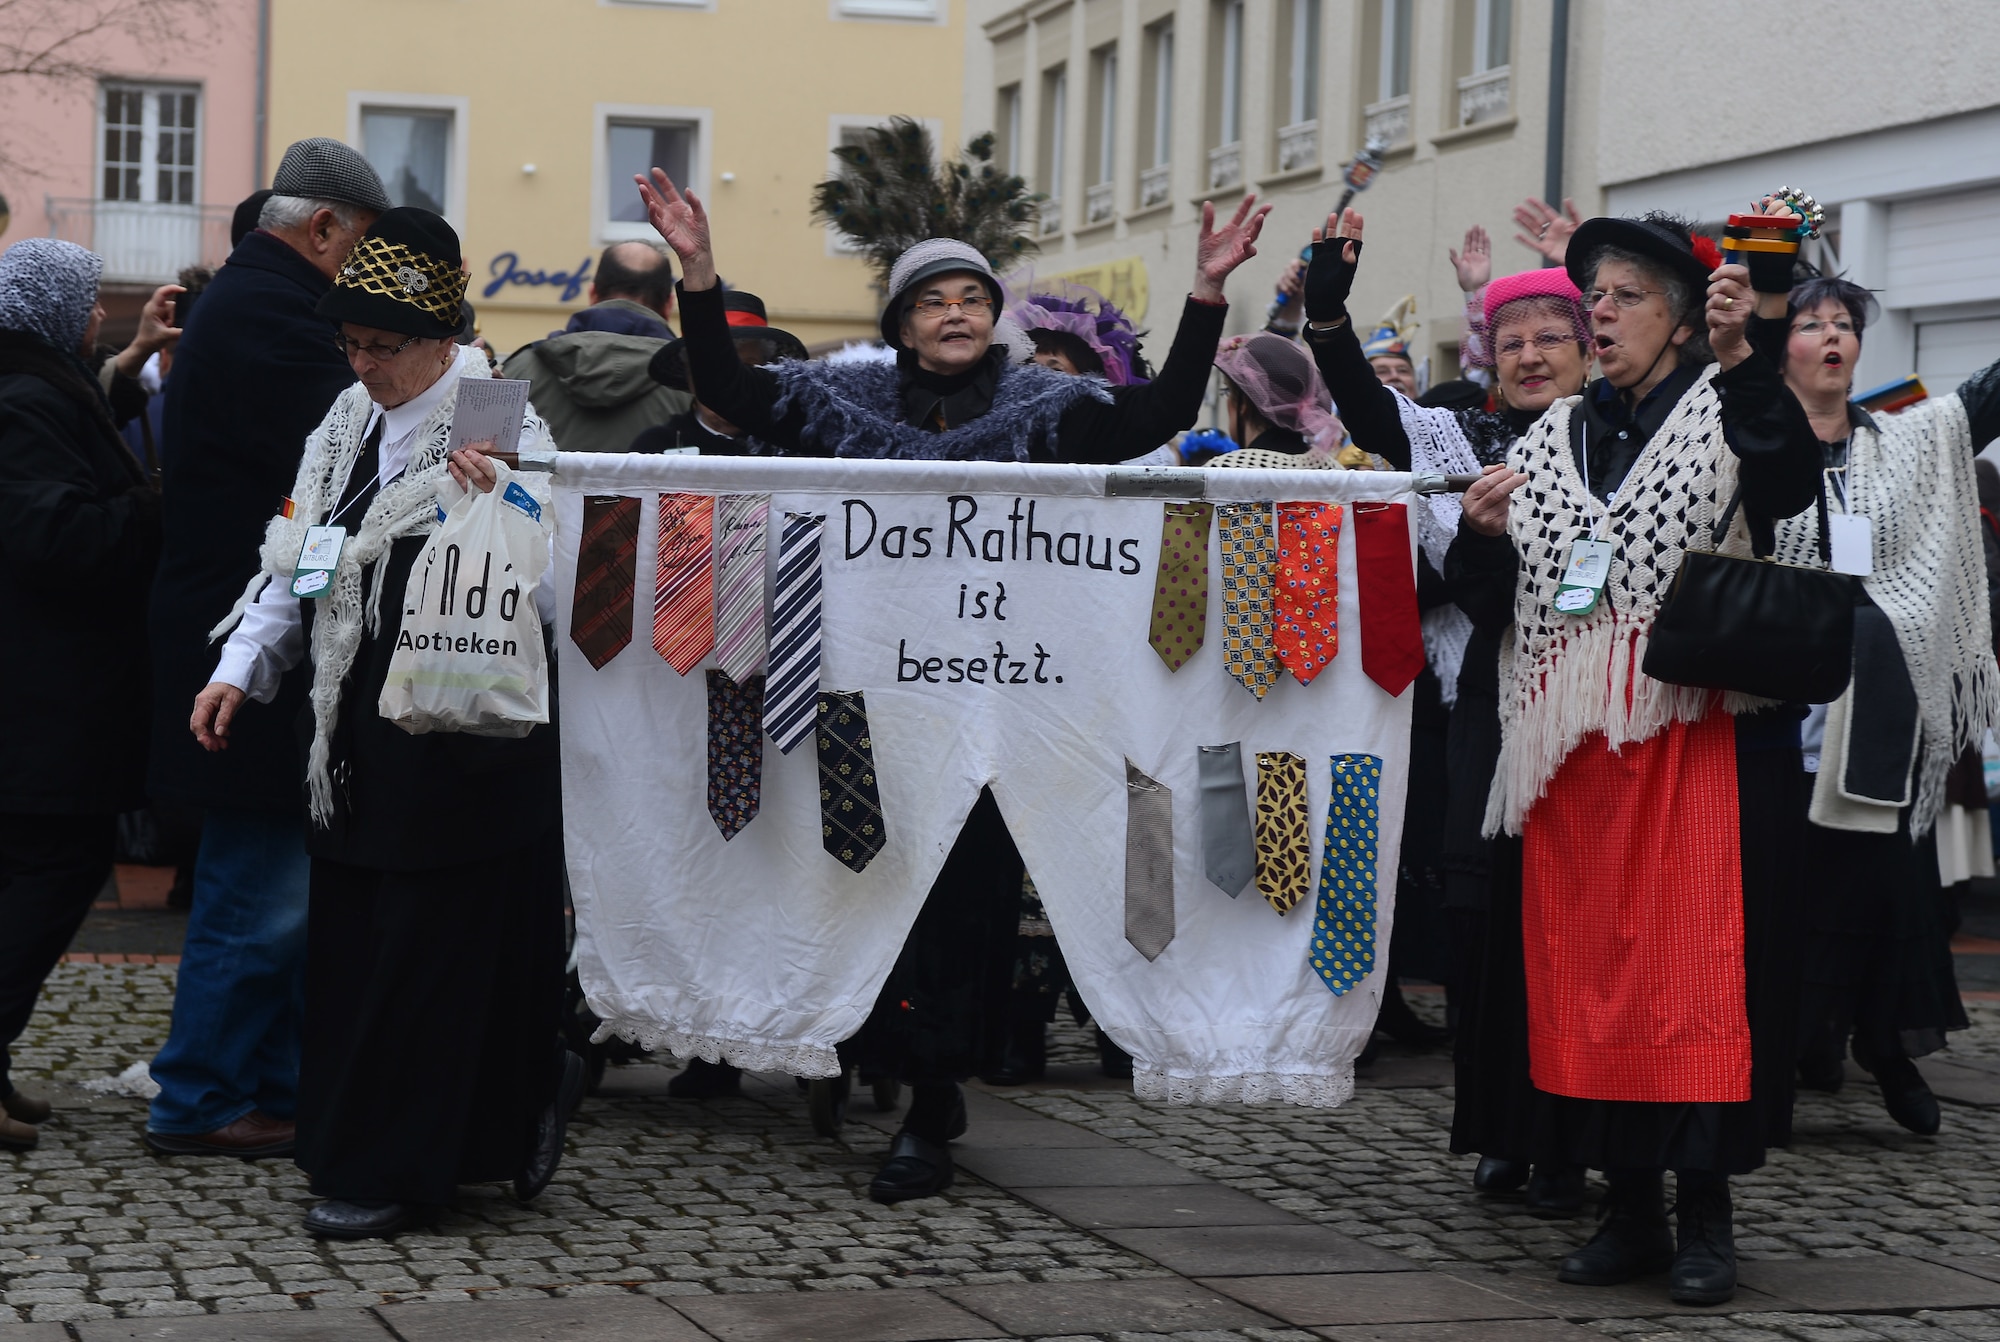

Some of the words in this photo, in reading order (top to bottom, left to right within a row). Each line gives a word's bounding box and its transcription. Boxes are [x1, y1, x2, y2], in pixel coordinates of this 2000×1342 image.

[483, 252, 593, 301] Josef
[303, 554, 329, 562] BITBURG
[842, 499, 933, 560] Das
[946, 495, 1141, 575] Rathaus
[407, 543, 521, 622] inda
[958, 581, 1007, 621] ist
[397, 630, 517, 656] Apotheken
[897, 638, 1064, 684] besetzt.
